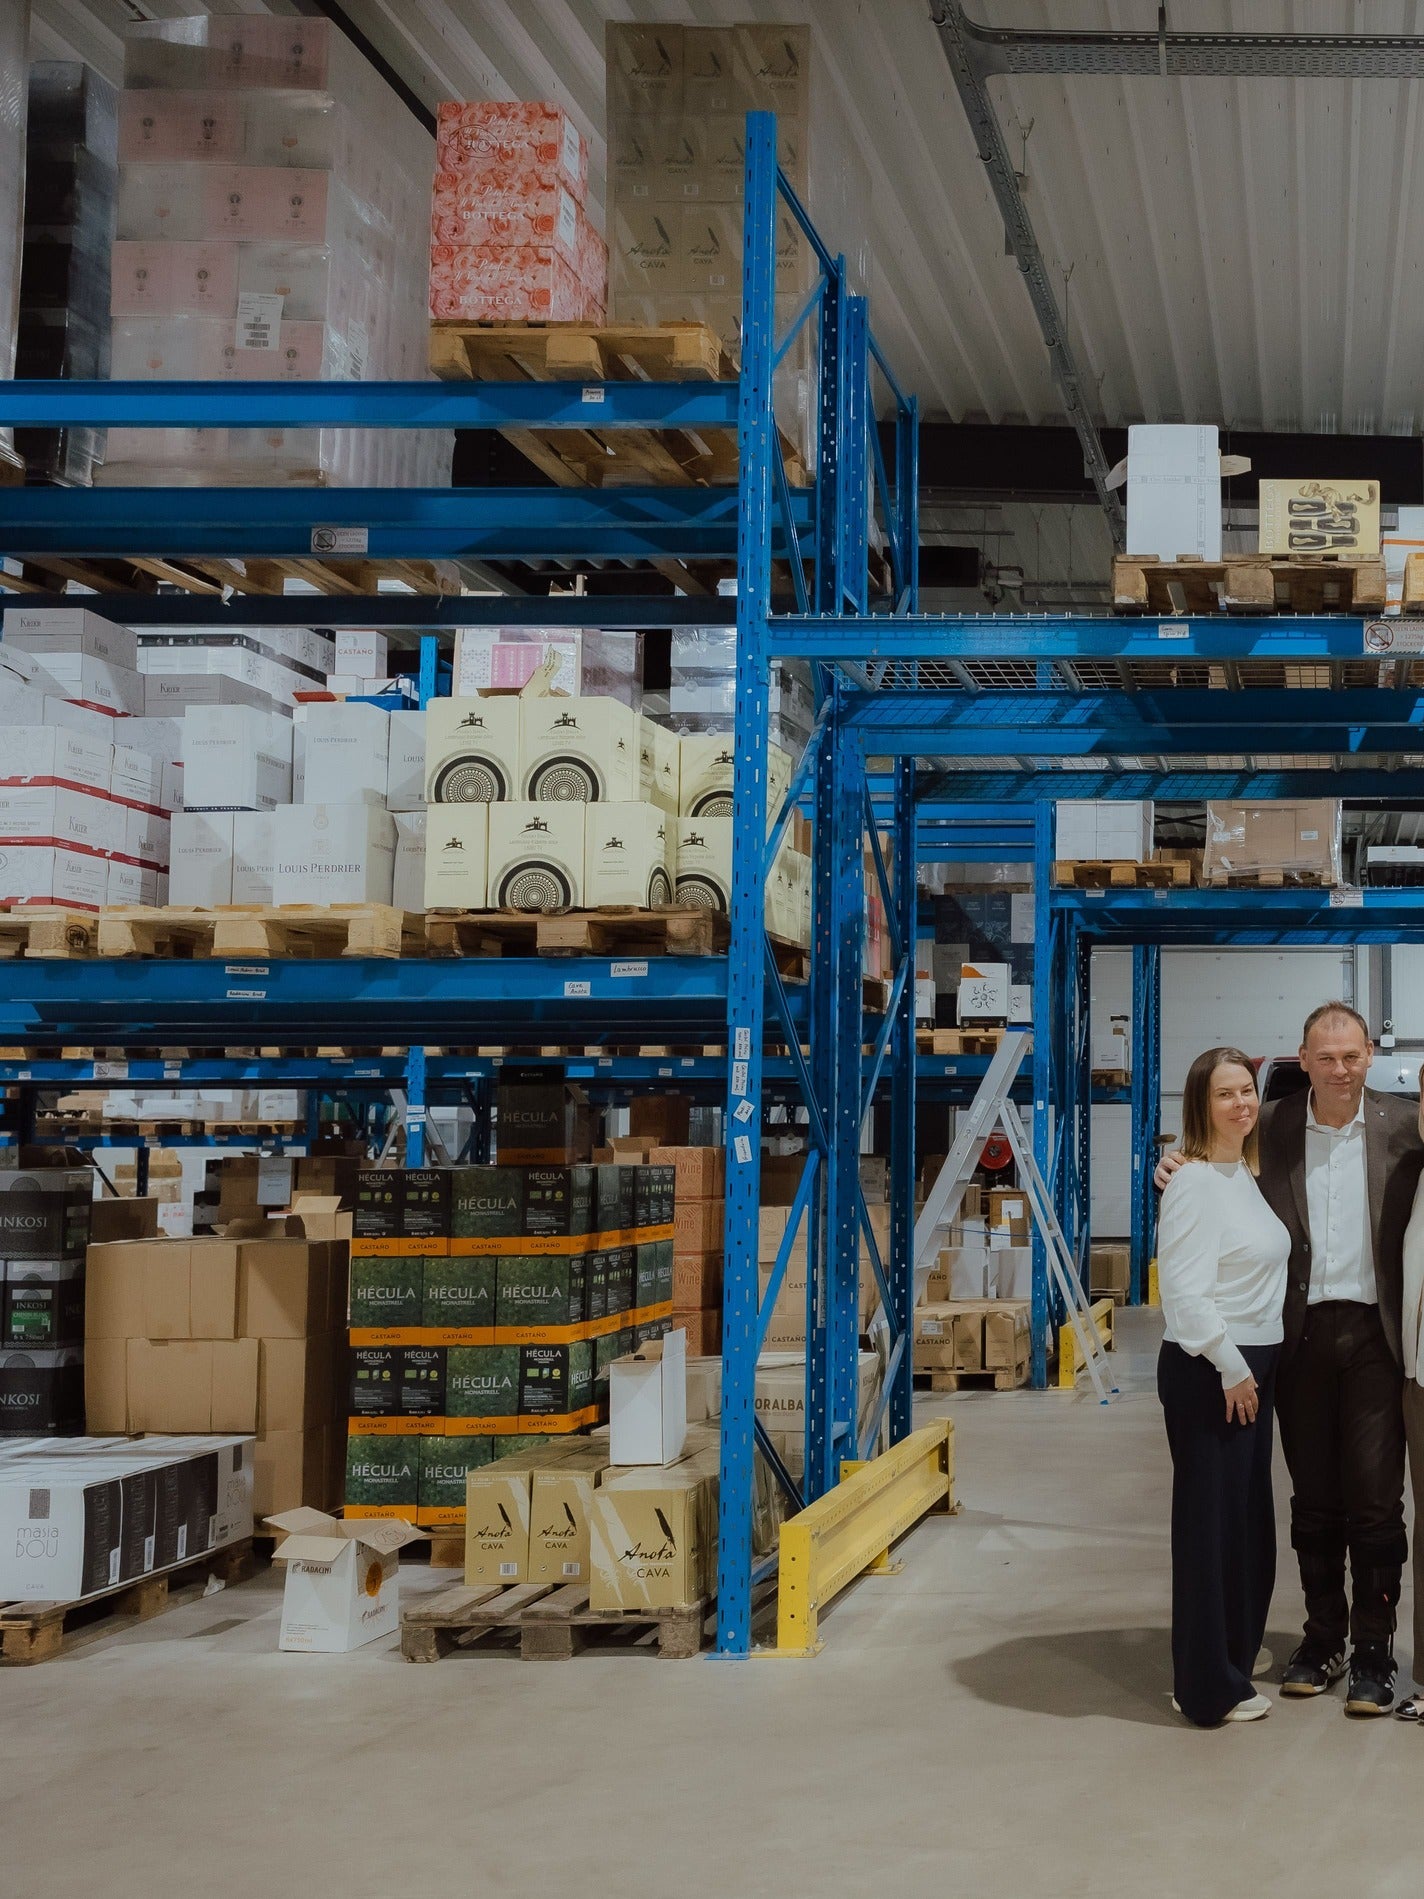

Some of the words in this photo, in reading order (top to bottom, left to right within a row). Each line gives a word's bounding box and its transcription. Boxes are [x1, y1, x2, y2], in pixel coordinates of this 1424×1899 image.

[467, 140, 529, 148] BOTTEGA
[463, 211, 525, 219] BOTTEGA
[459, 296, 522, 304] BOTTEGA
[1265, 482, 1275, 549] BOTTEGA
[403, 754, 424, 763] LOUIS
[236, 865, 255, 873] LOUIS
[278, 863, 309, 874] LOUIS
[310, 863, 361, 873] PERDRIER
[614, 964, 647, 974] Lambrusco
[679, 1162, 701, 1173] Wine
[358, 1173, 393, 1182] HÉCULA
[458, 1198, 517, 1211] HÉCULA
[678, 1273, 701, 1284] Wine
[357, 1286, 416, 1299] HÉCULA
[429, 1286, 488, 1299] HÉCULA
[502, 1284, 562, 1298] HÉCULA
[16, 1302, 47, 1310] INKOSI
[916, 1337, 951, 1345] CASTAÑO
[357, 1350, 391, 1359] HÉCULA
[404, 1350, 438, 1359] HÉCULA
[526, 1348, 562, 1358] HÉCULA
[452, 1374, 512, 1389] HÉCULA
[0, 1394, 40, 1405] NKOSI
[755, 1399, 804, 1411] ORALBA
[352, 1463, 411, 1477] HÉCULA
[425, 1465, 467, 1478] HÉCU
[17, 1526, 59, 1538] masia
[473, 1525, 513, 1539] Anota
[537, 1525, 577, 1538] Anota
[481, 1542, 504, 1550] CAVA
[618, 1541, 676, 1562] Anota
[302, 1566, 332, 1574] RADACINI
[637, 1568, 671, 1578] CAVA
